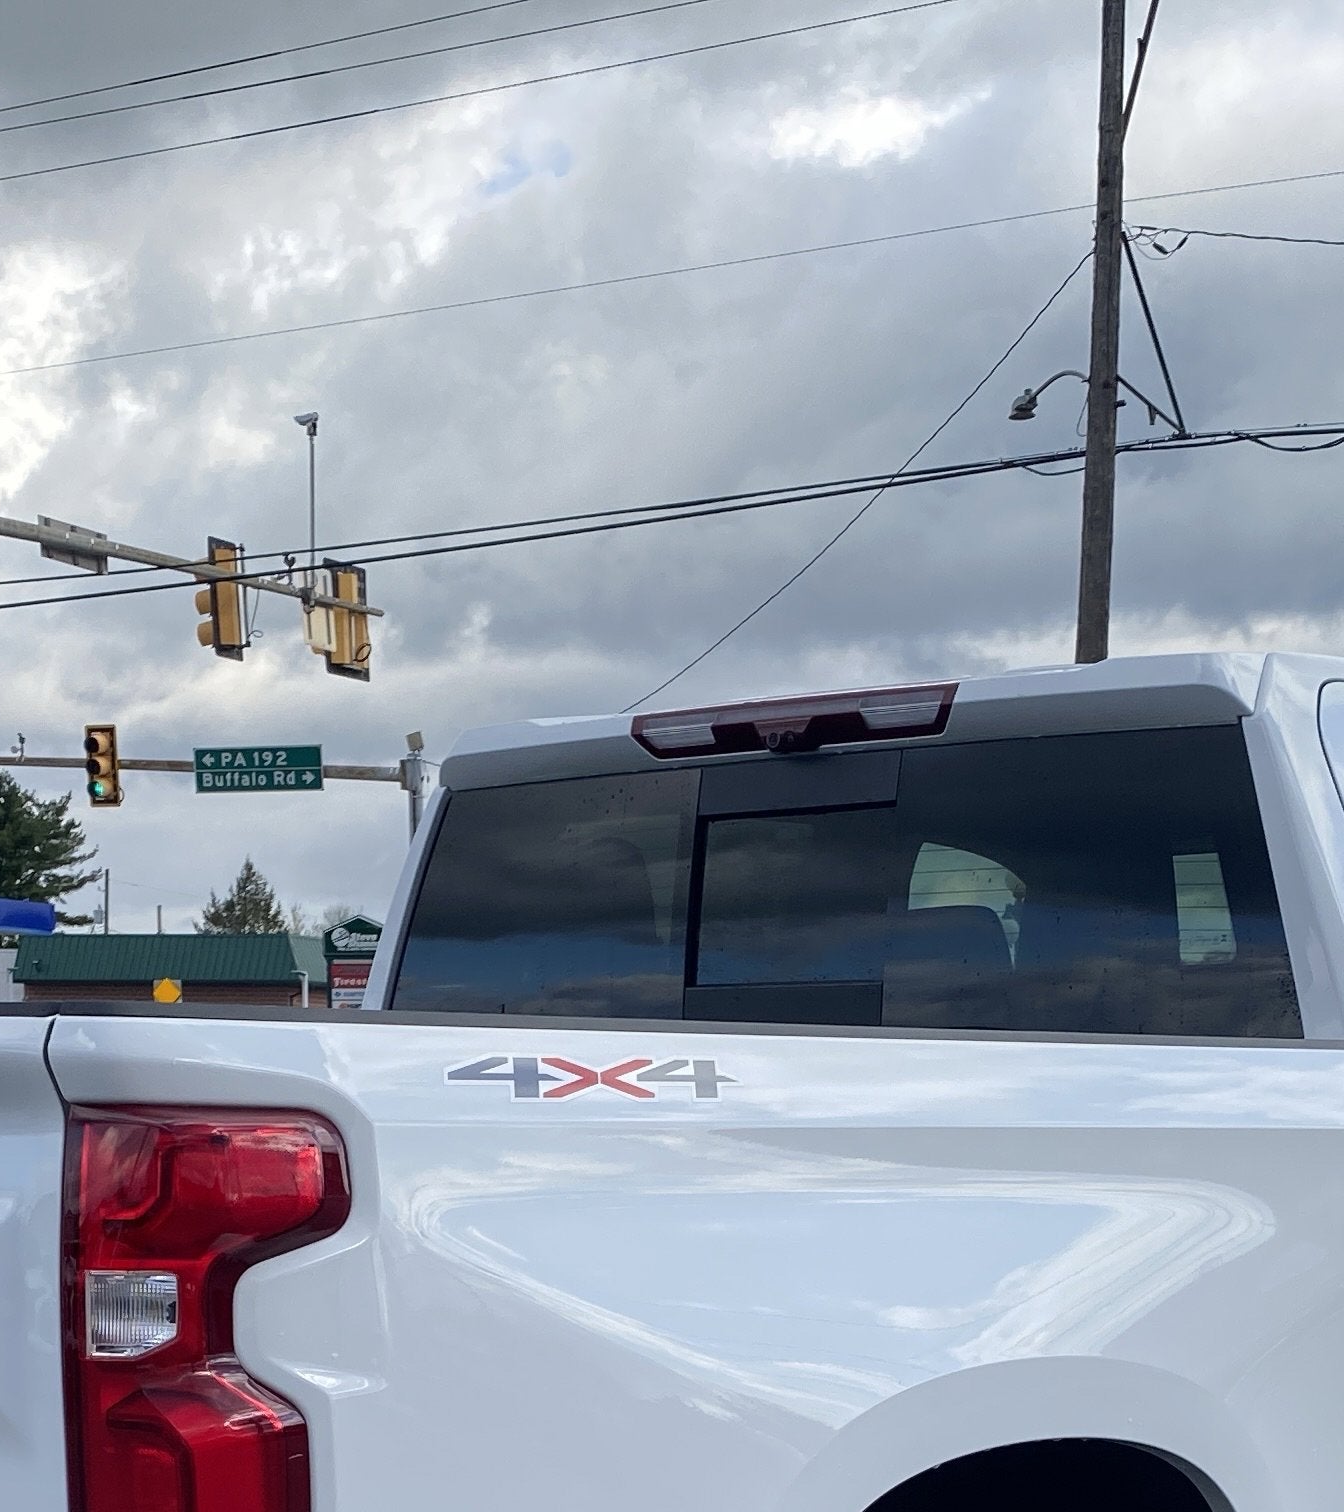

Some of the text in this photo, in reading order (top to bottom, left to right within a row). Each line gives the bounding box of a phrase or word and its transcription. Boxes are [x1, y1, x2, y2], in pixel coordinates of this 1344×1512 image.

[221, 751, 288, 767] PA 192
[202, 770, 296, 787] Buffalo Rd
